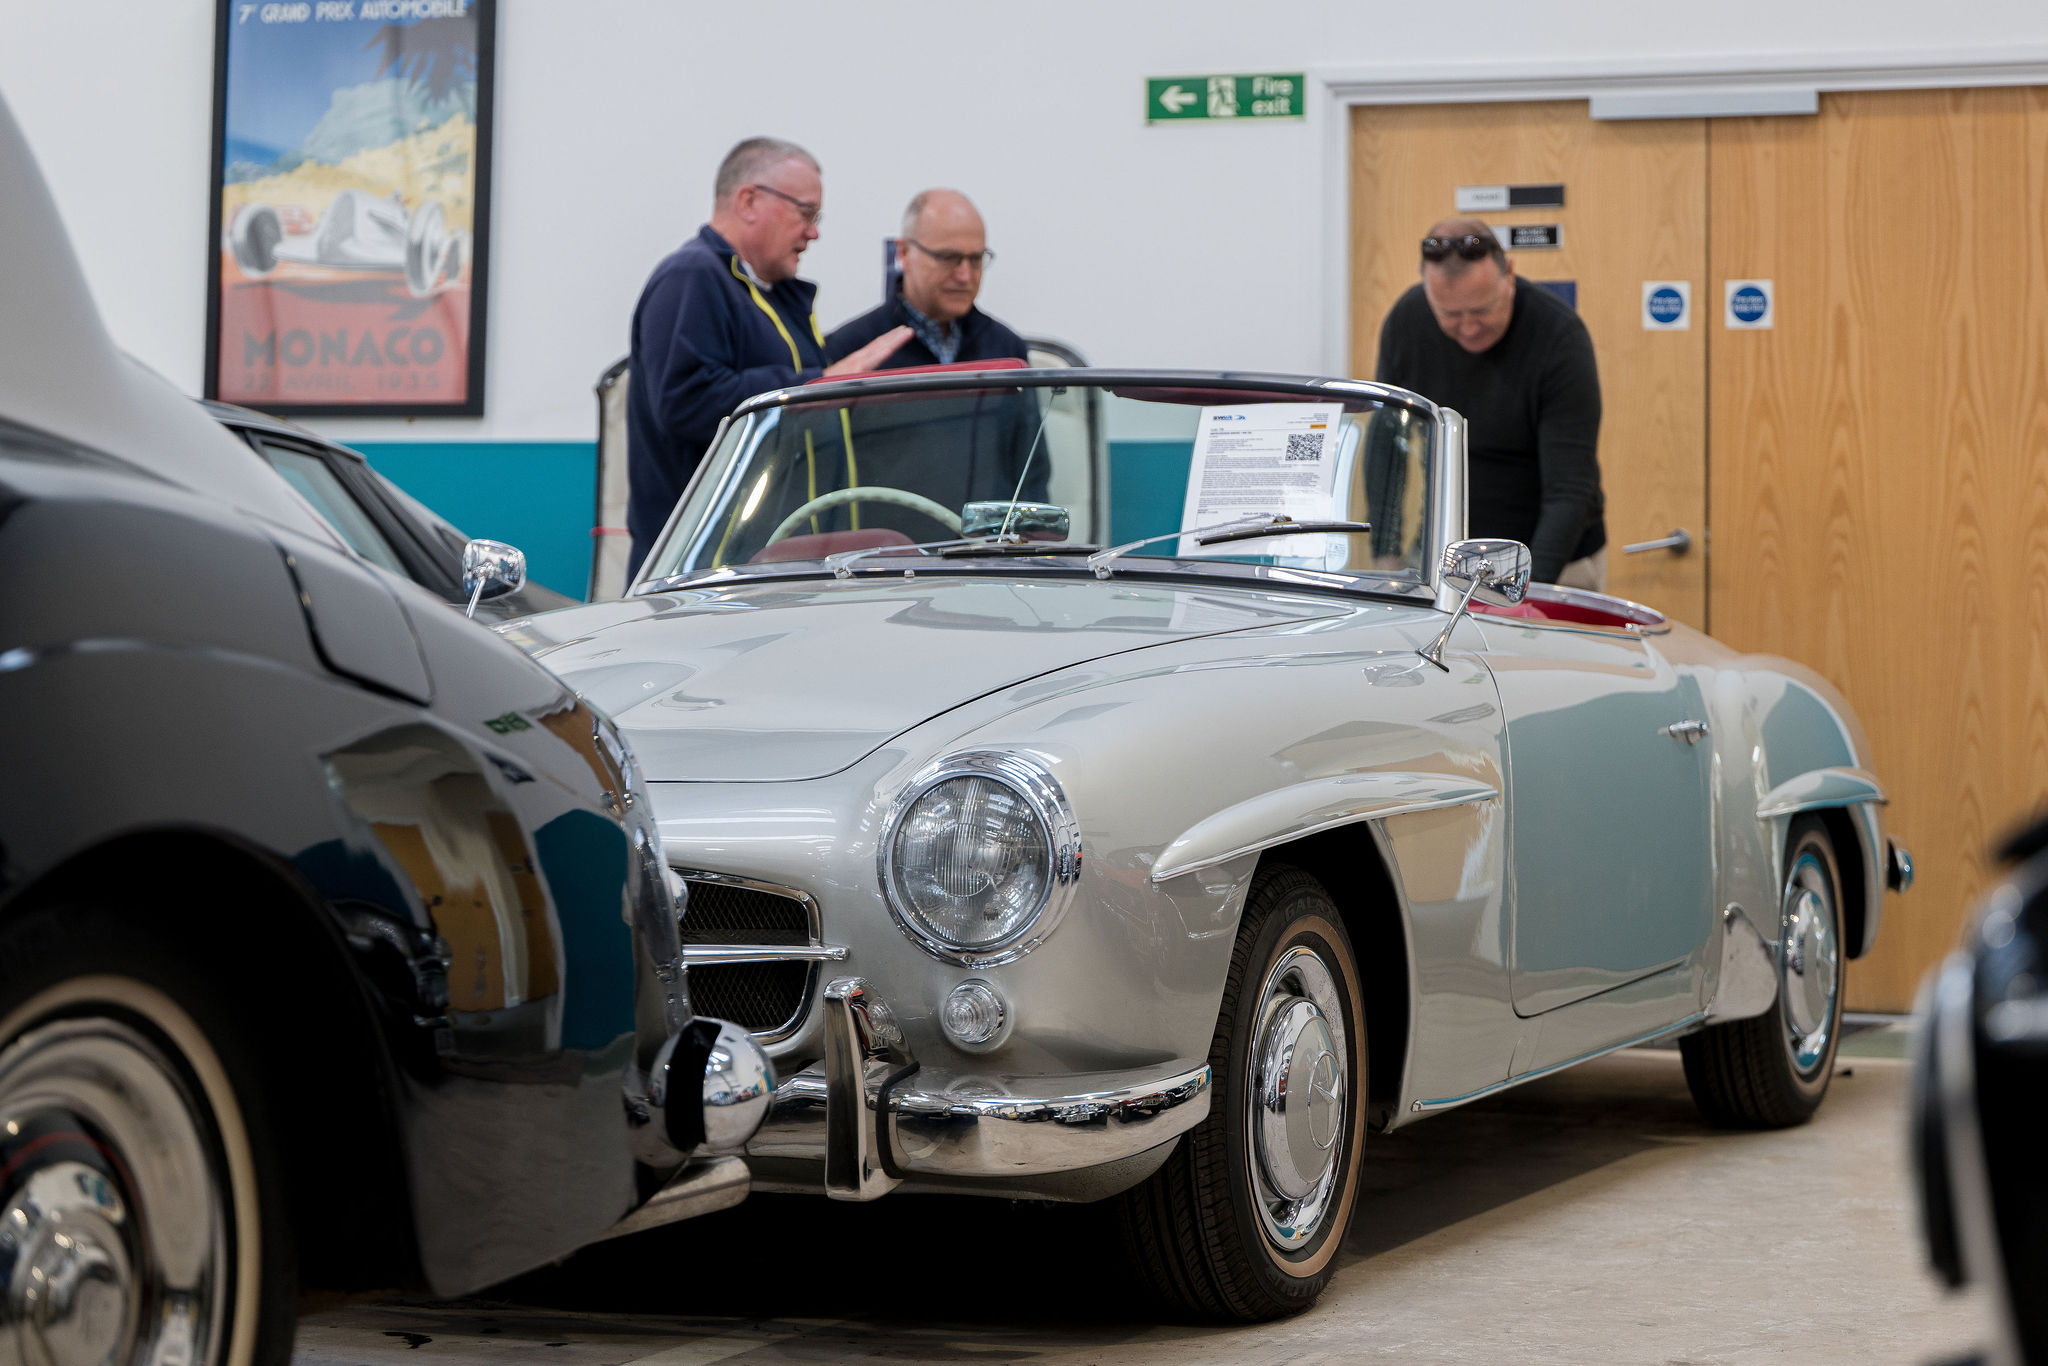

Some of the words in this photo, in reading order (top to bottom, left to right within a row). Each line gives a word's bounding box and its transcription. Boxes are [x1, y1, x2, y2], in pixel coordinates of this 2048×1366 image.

[260, 2, 312, 24] GRAND
[315, 1, 355, 22] PRIX
[359, 0, 467, 21] AUTOMOBILE
[1252, 76, 1294, 97] Fire
[1251, 96, 1292, 116] exit
[243, 327, 445, 368] MONACO
